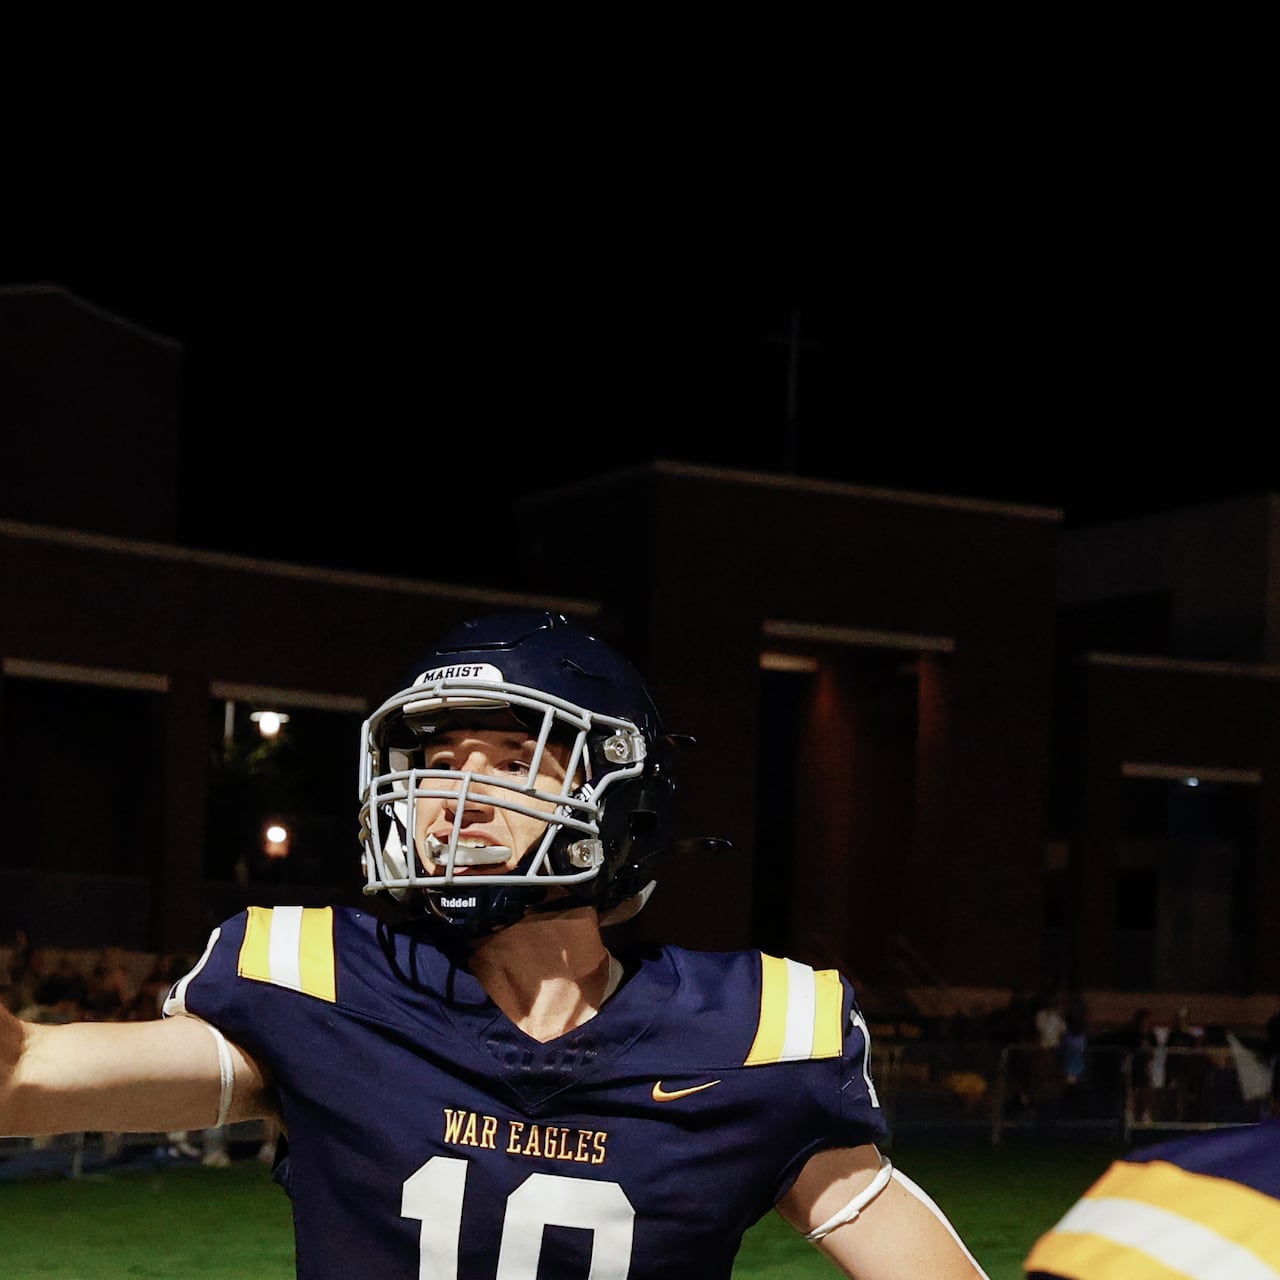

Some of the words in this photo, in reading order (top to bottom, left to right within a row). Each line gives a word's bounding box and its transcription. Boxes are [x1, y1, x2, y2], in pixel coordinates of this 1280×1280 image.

[423, 666, 483, 684] MARIST
[440, 897, 477, 908] Riddell
[443, 1108, 498, 1150] WAR
[506, 1121, 609, 1165] EAGLES
